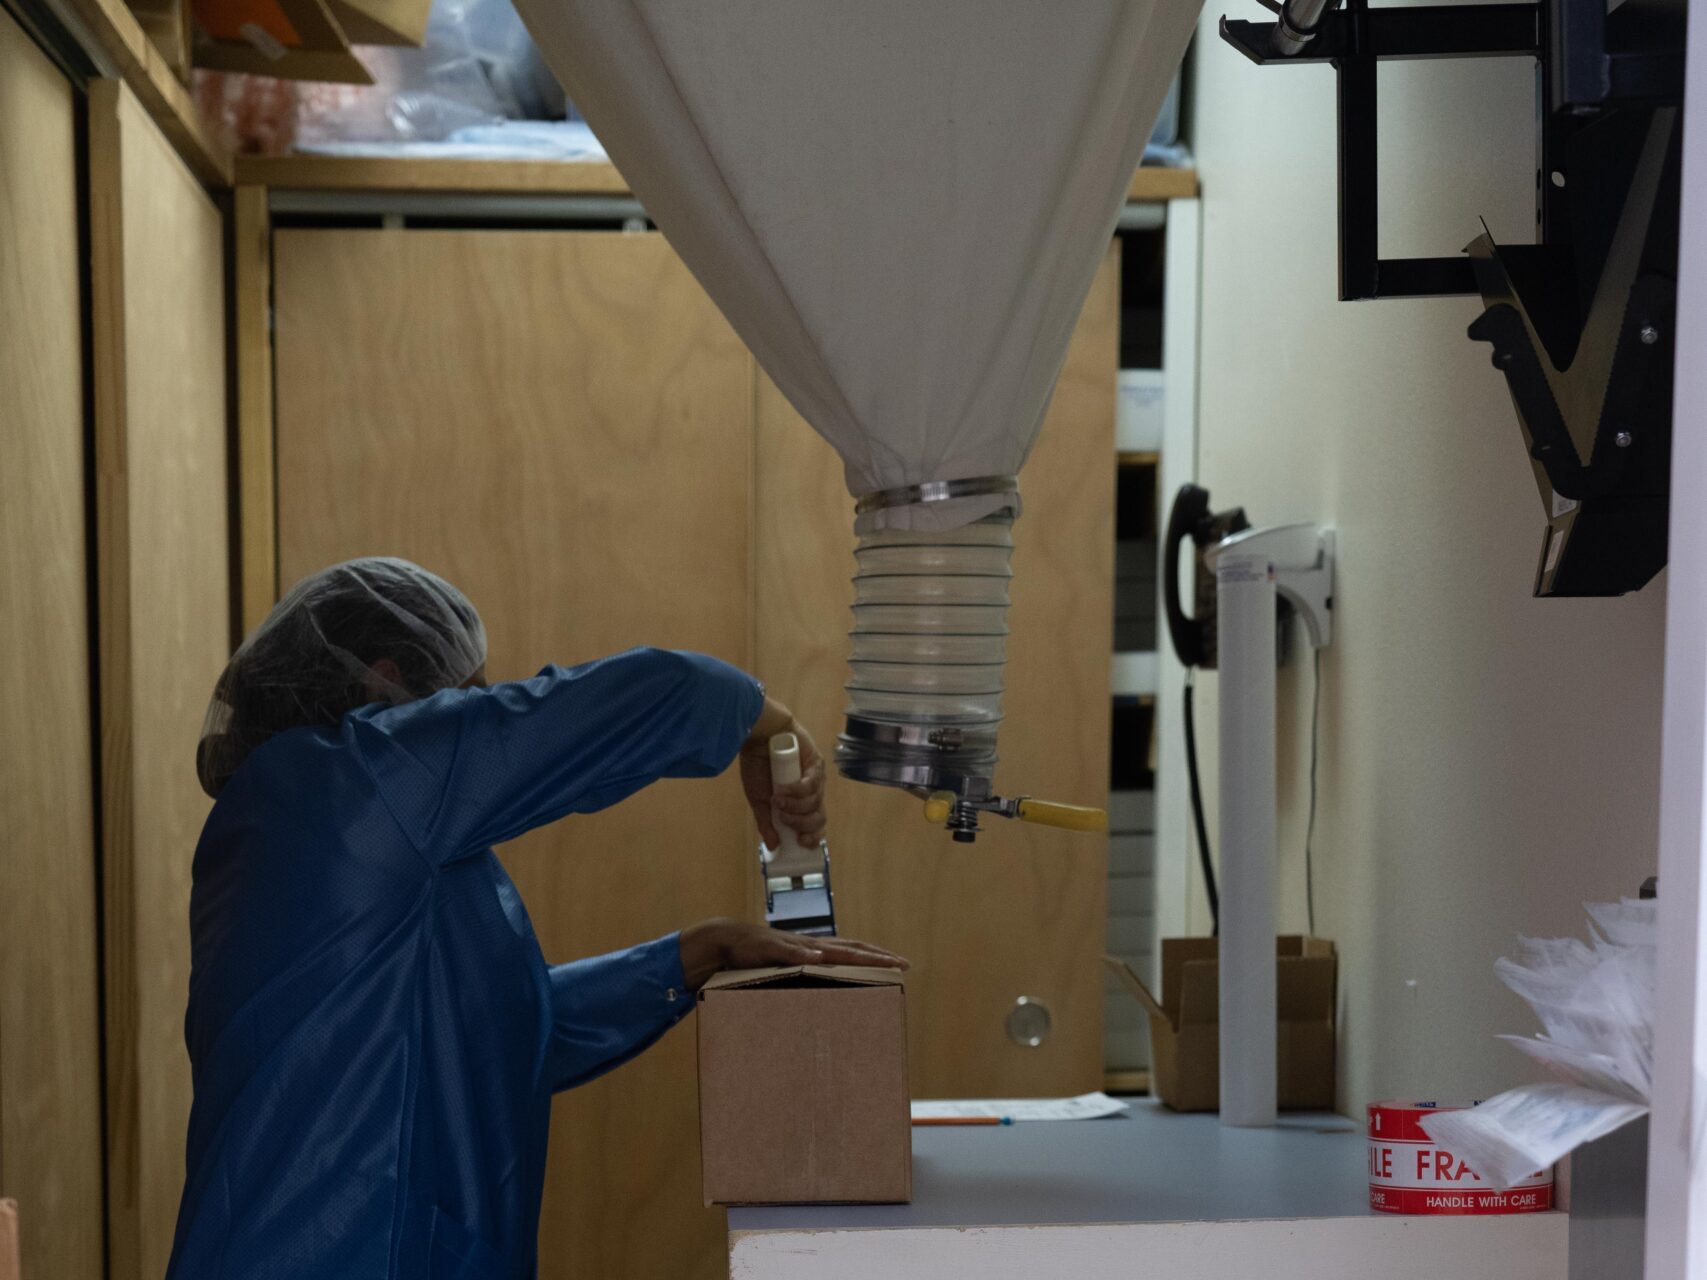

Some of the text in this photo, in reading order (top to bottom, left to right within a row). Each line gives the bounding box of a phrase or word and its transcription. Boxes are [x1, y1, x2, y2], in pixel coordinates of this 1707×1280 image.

[1369, 1147, 1481, 1181] ILE FRA
[1426, 1196, 1474, 1208] HANDLE
[1479, 1195, 1507, 1208] WITH
[1511, 1193, 1537, 1207] CARE
